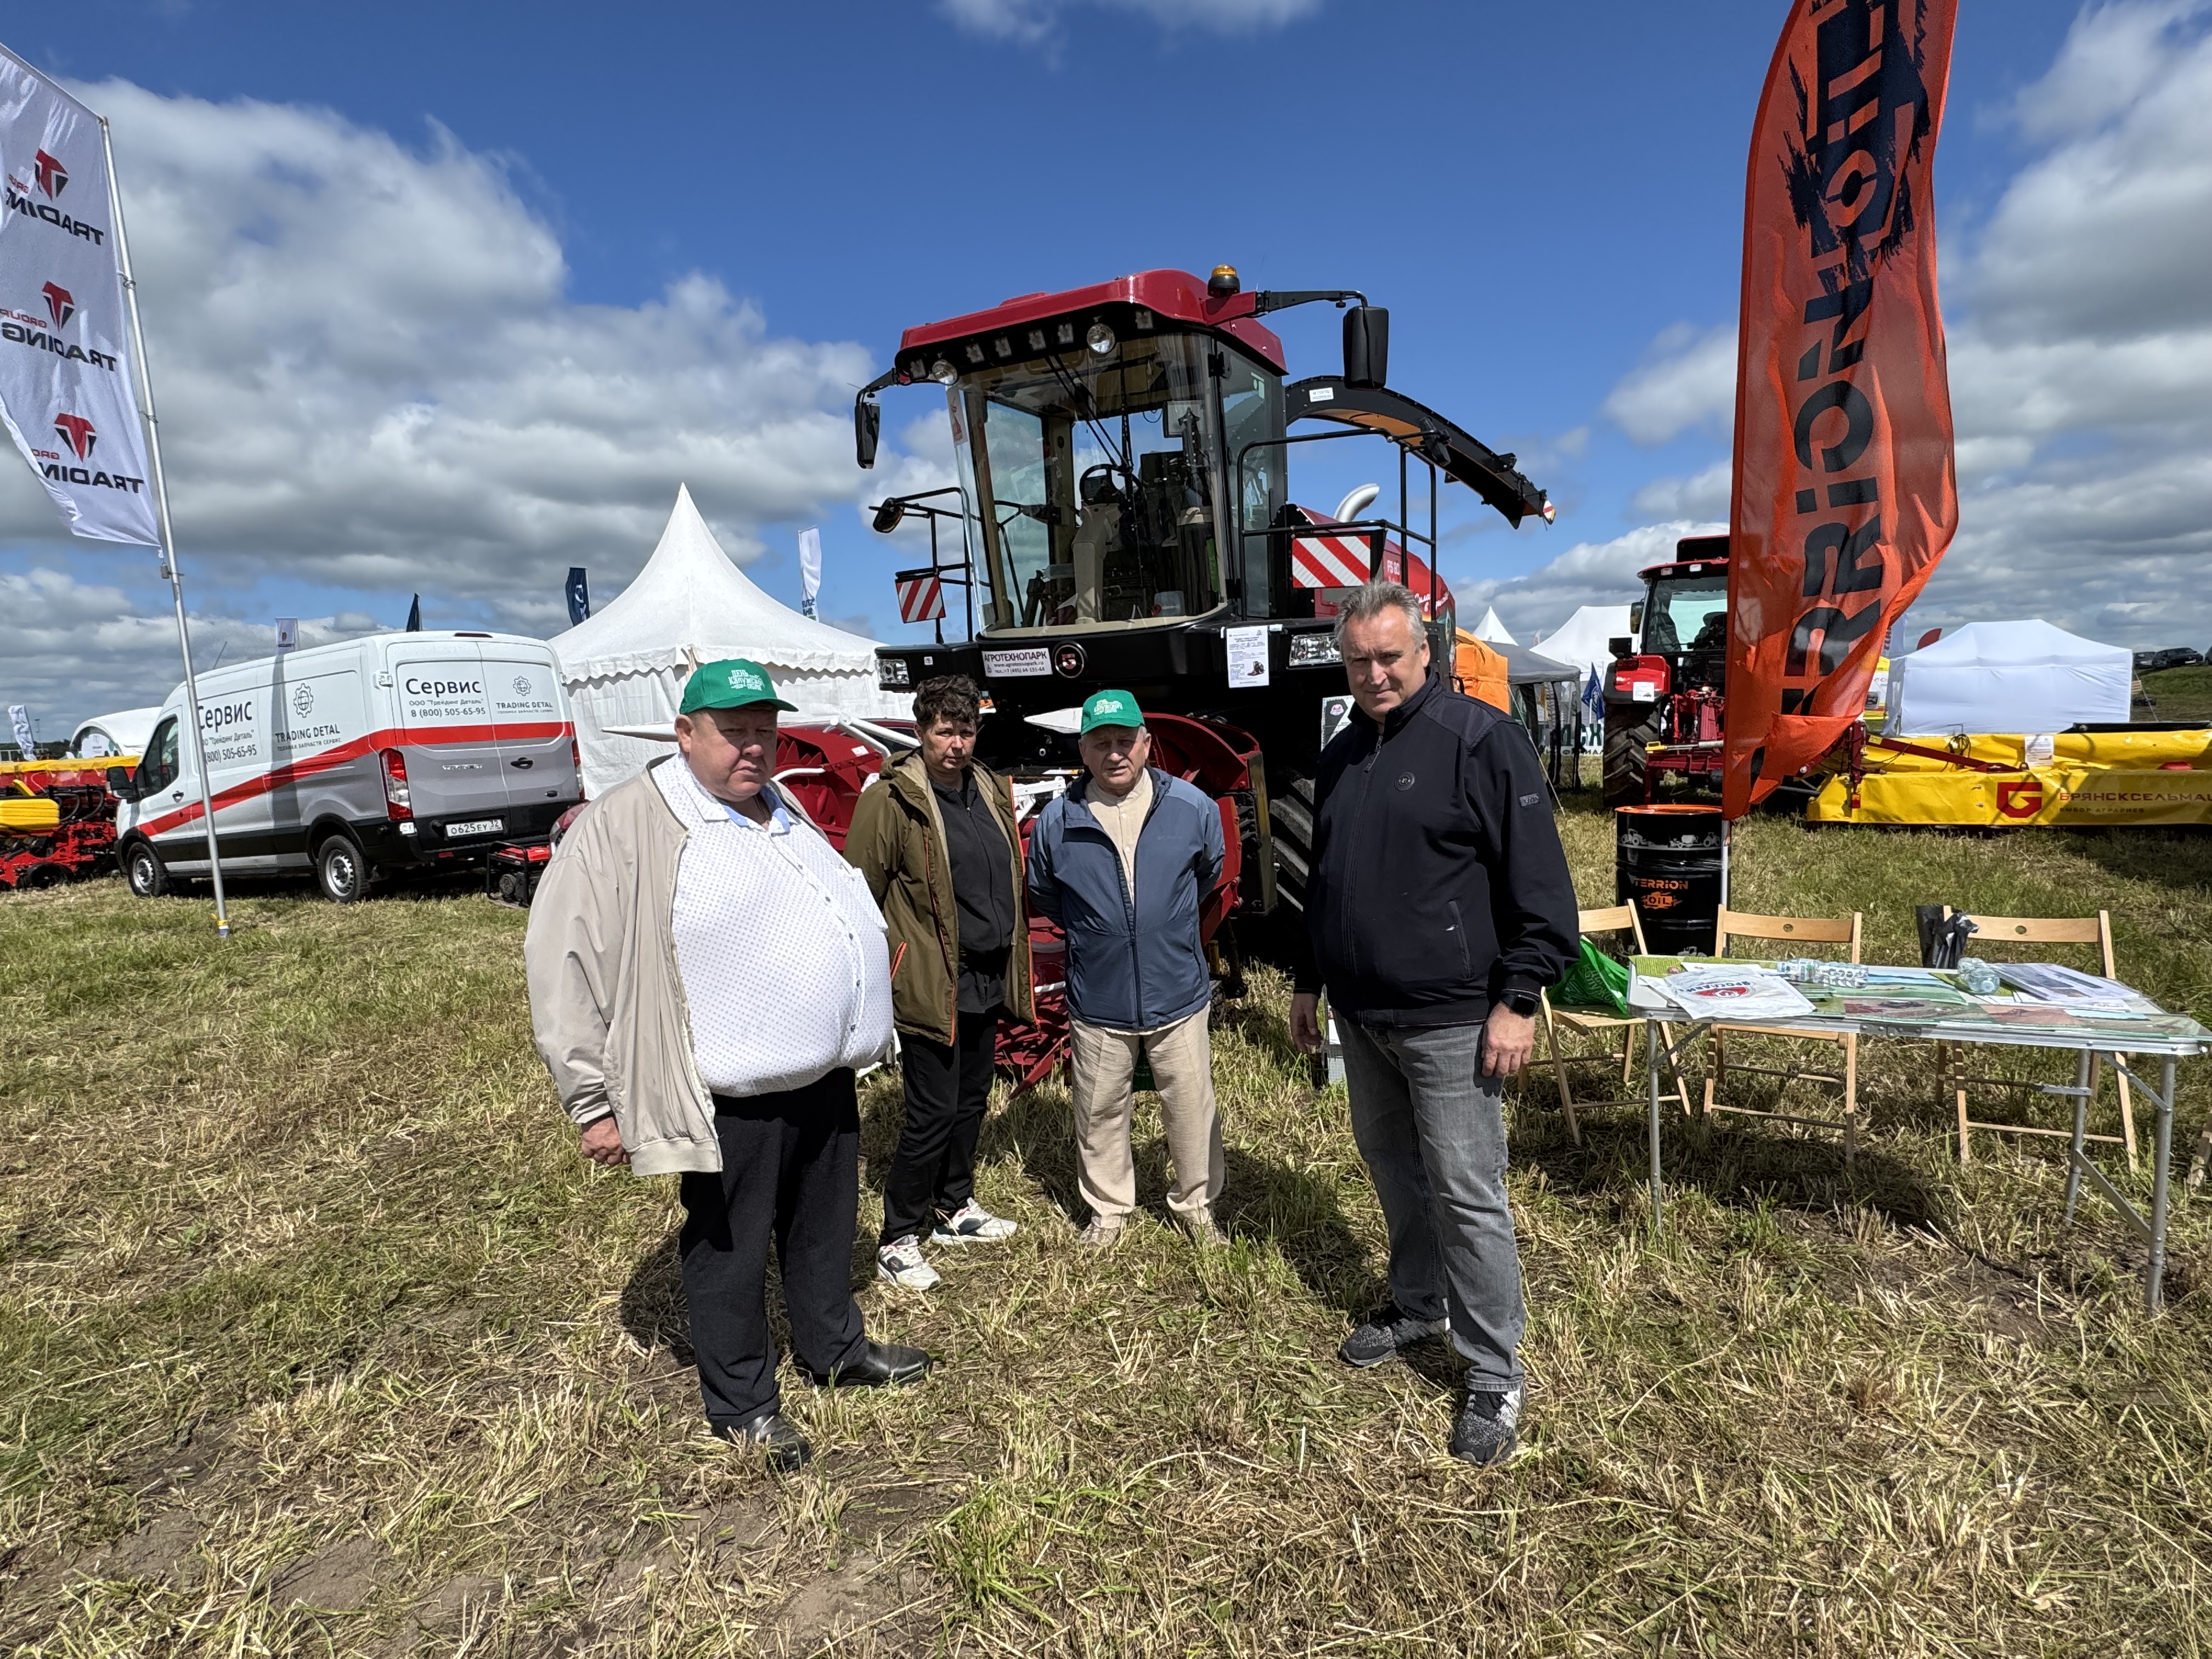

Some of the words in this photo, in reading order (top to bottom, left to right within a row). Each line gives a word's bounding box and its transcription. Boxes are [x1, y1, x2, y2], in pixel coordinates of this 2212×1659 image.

[984, 651, 1048, 662] АГРОТЕХНОПАРК
[405, 678, 482, 697] Сервис
[419, 708, 442, 718] (800)
[444, 707, 486, 716] 505-65-95
[275, 728, 312, 743] TRADING
[313, 723, 341, 738] DETAL
[223, 744, 257, 760] 505-65-95
